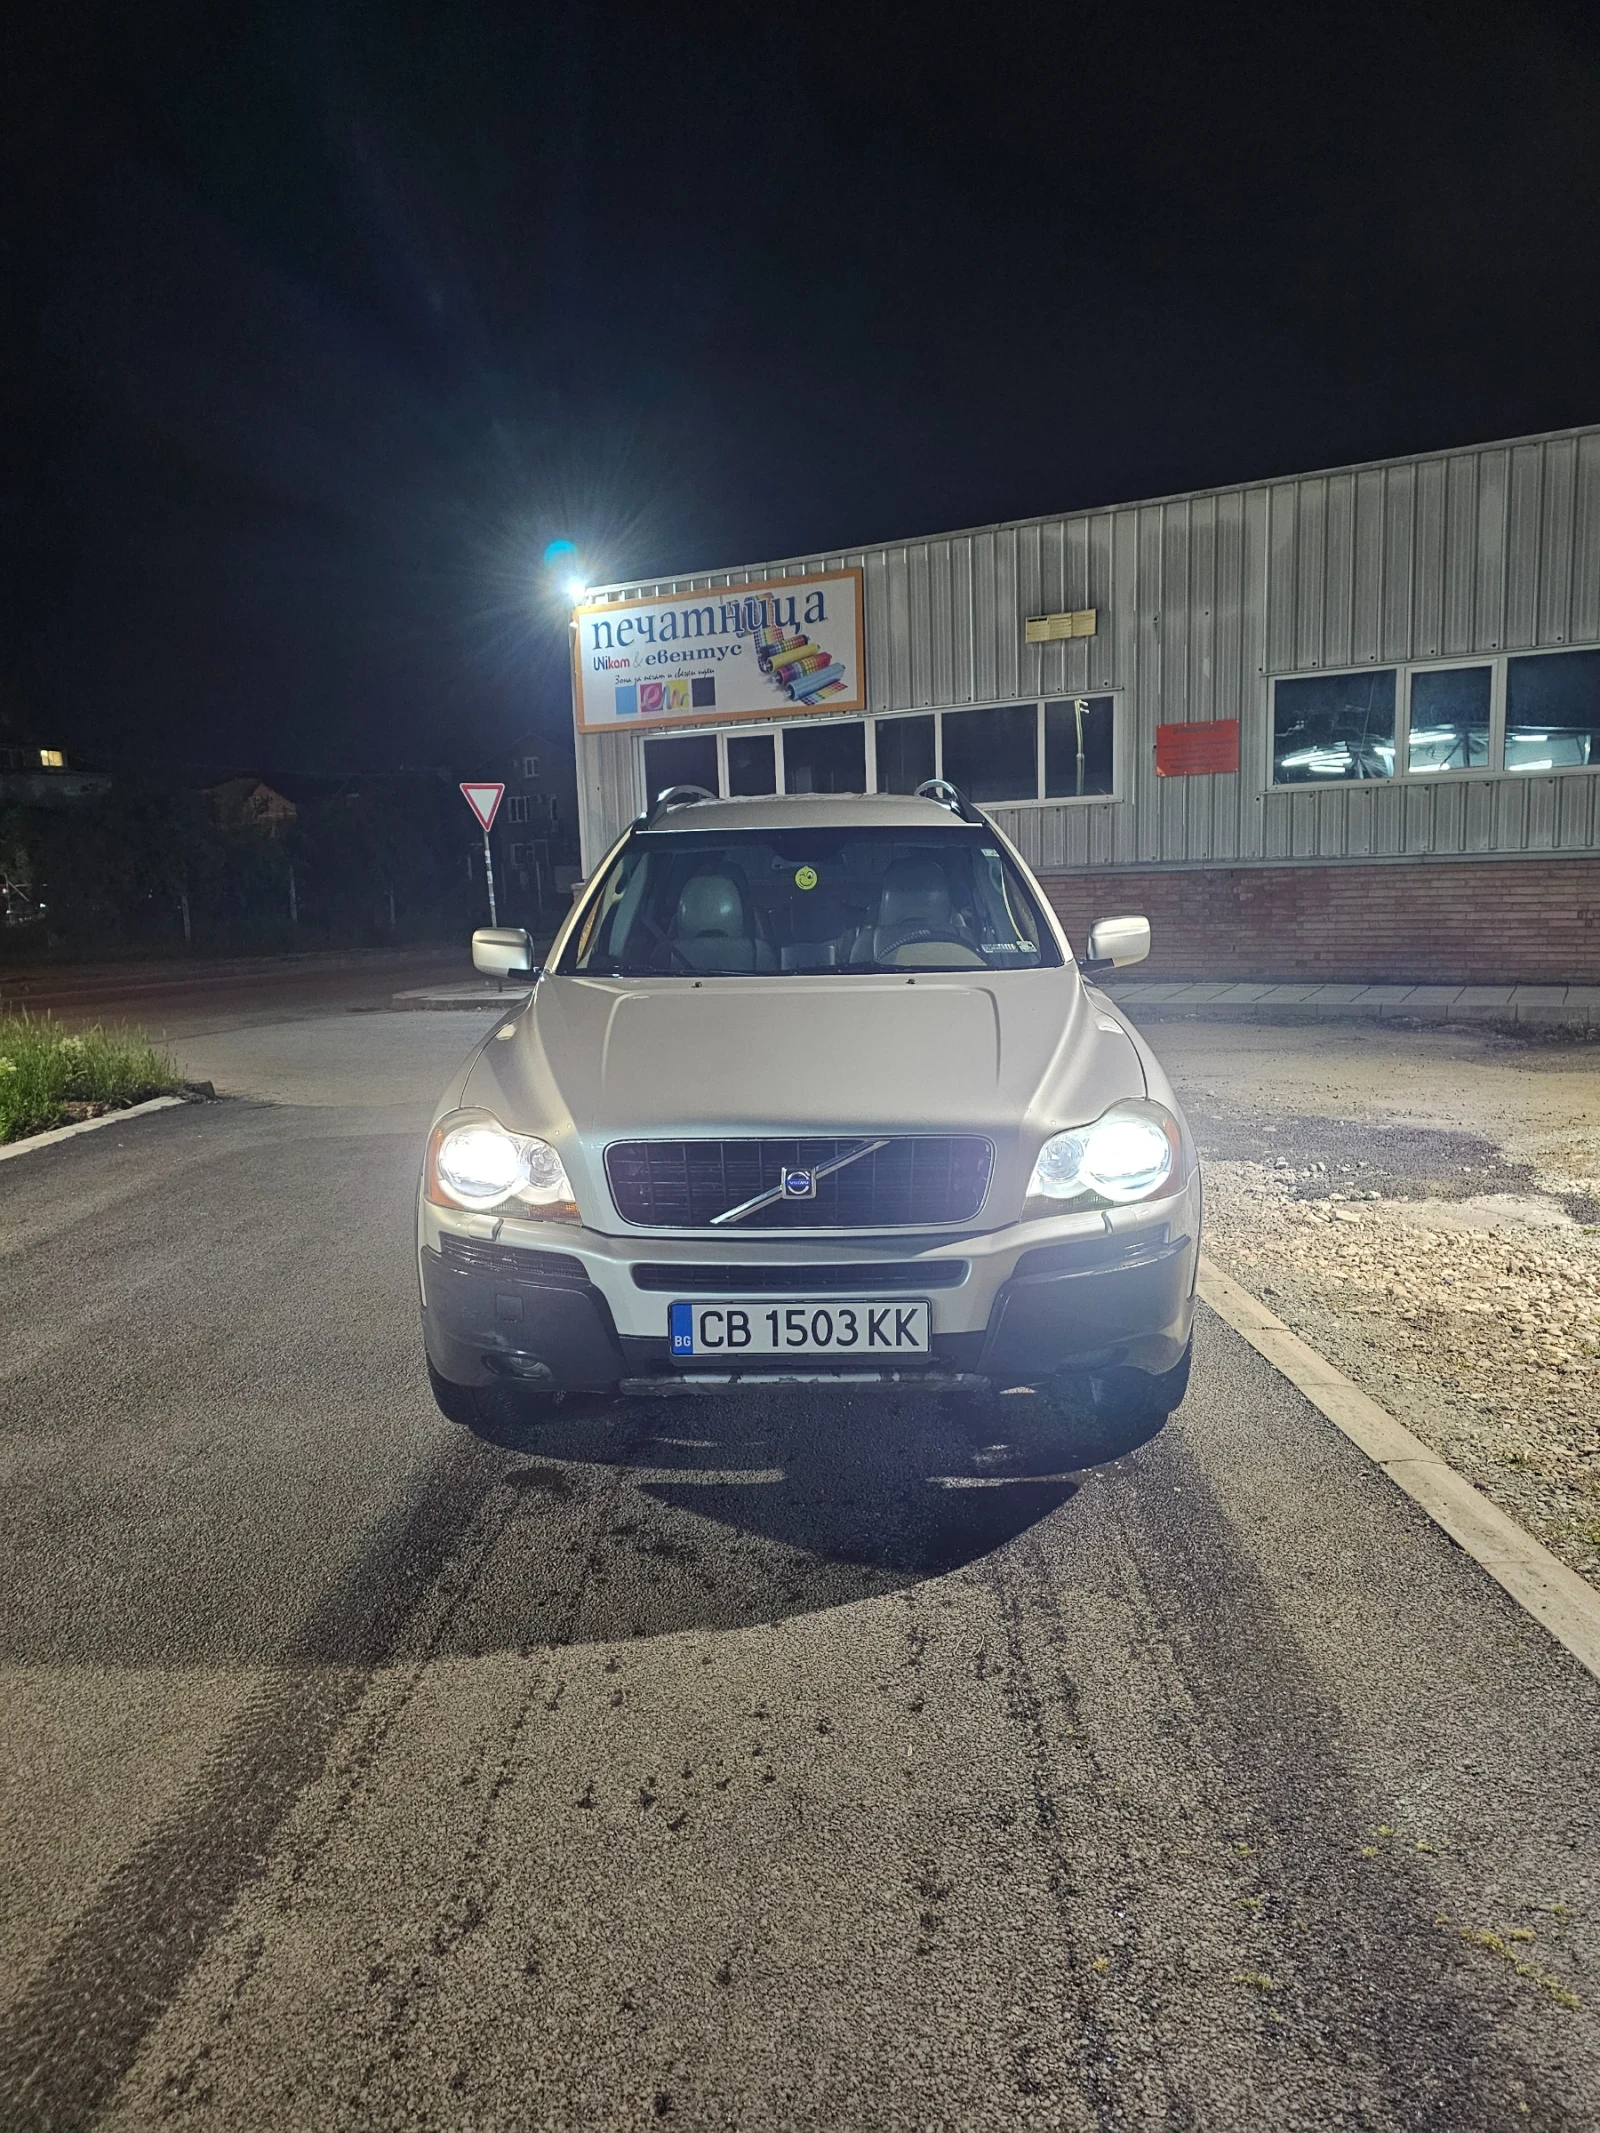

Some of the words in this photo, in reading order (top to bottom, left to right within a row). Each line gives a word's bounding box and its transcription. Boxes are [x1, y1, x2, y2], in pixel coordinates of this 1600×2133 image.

[592, 591, 827, 650] печатница
[633, 651, 643, 668] &
[645, 644, 743, 666] евентус
[615, 675, 632, 685] Зона
[634, 677, 642, 687] за
[700, 1310, 752, 1347] CB
[765, 1309, 859, 1347] 1503
[867, 1308, 920, 1346] KK
[674, 1335, 692, 1347] BG
